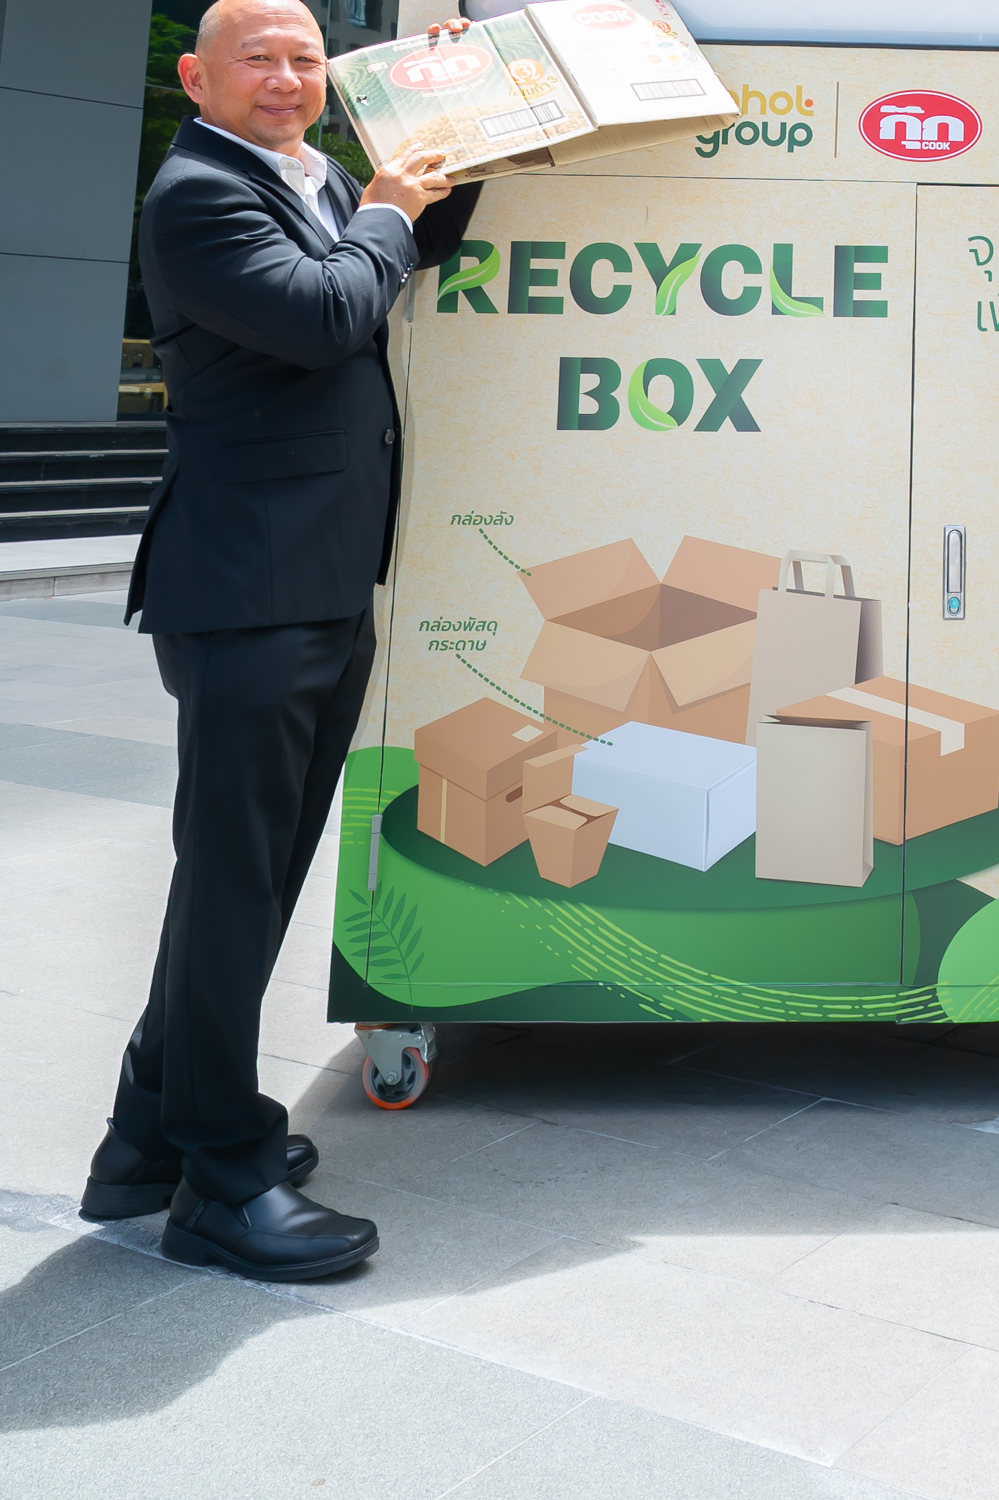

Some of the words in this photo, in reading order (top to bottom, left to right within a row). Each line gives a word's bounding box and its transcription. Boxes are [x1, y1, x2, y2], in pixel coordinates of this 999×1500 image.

[576, 9, 635, 25] COOK
[695, 121, 814, 158] group
[921, 141, 951, 151] COOK
[436, 240, 888, 318] RECYCLE
[557, 357, 763, 432] BOX
[450, 510, 515, 526] กล่องลัง
[418, 616, 498, 636] กล่องพัสดุ
[428, 639, 487, 652] กระดาษ
